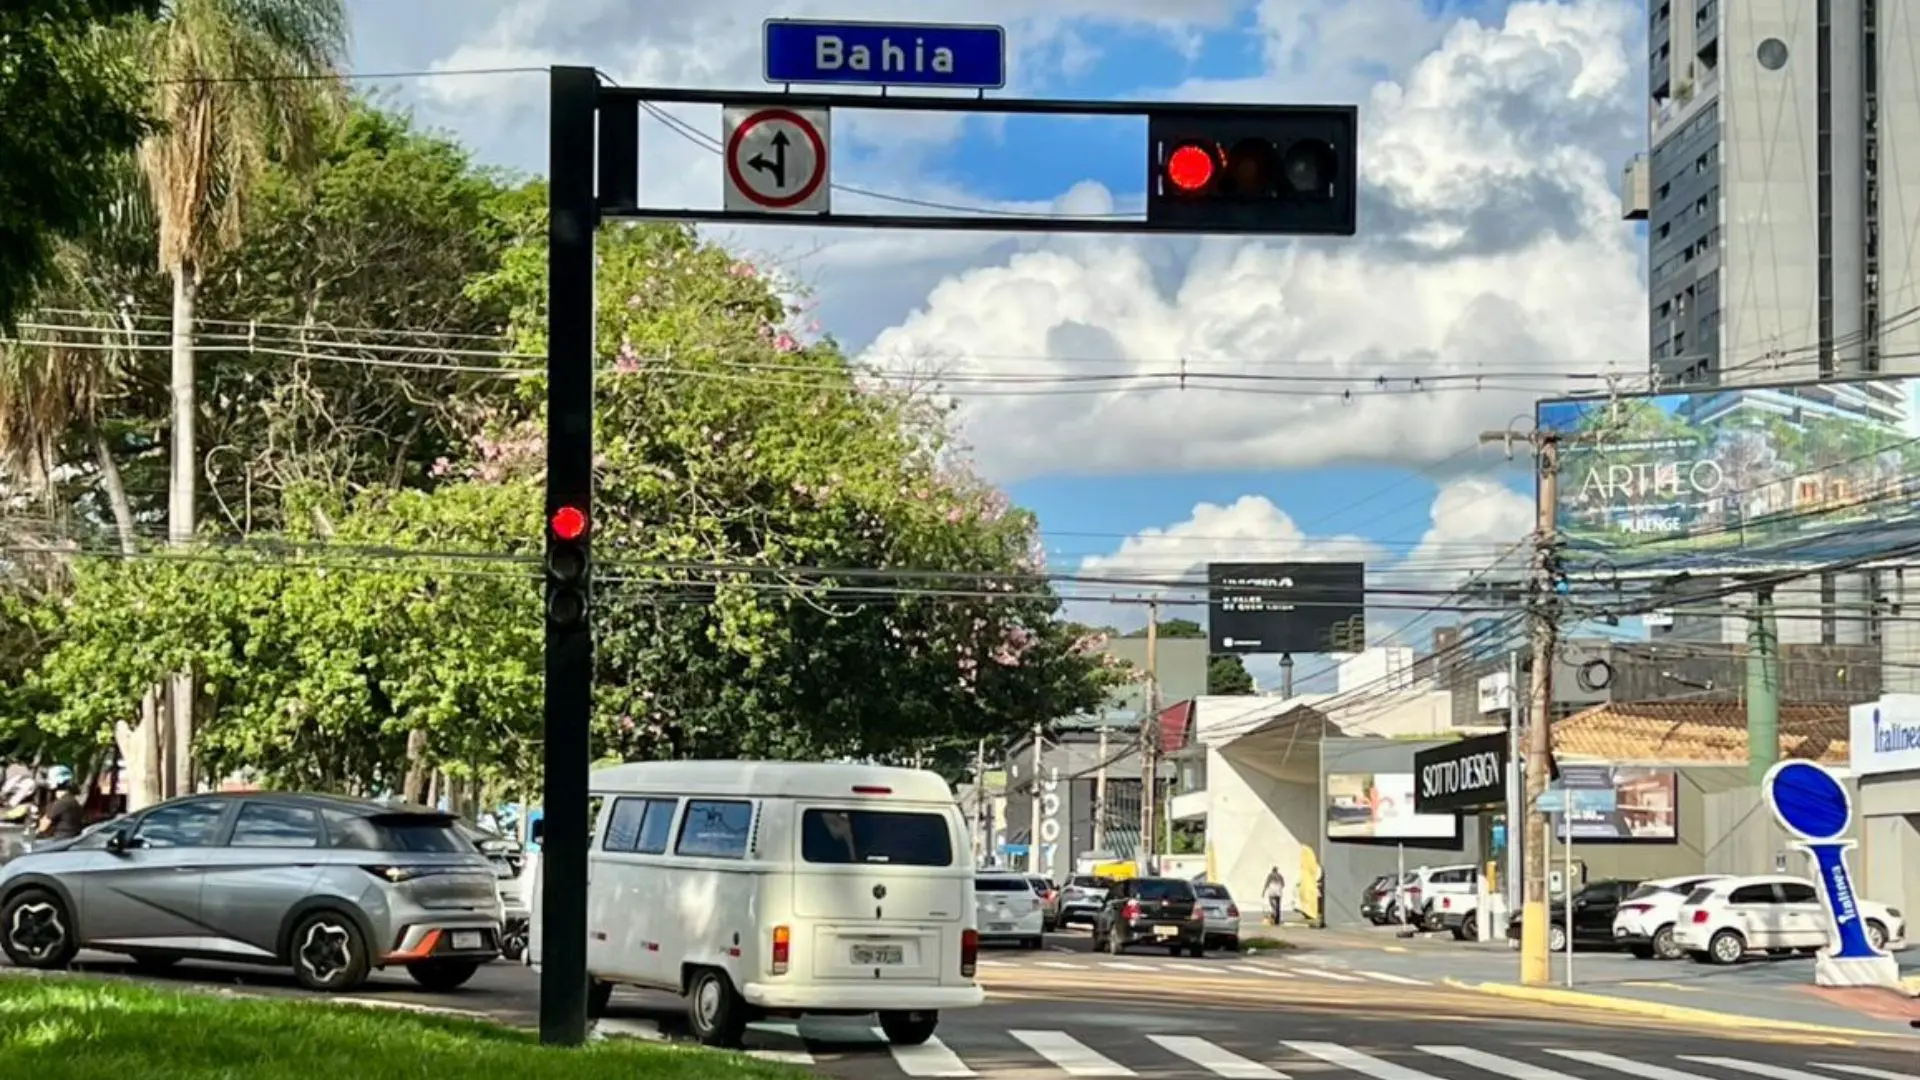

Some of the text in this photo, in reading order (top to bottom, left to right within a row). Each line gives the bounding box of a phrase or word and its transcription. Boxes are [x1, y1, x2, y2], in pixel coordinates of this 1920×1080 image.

[815, 35, 953, 73] Bahia
[1422, 752, 1499, 798] SOTTO DESIGN
